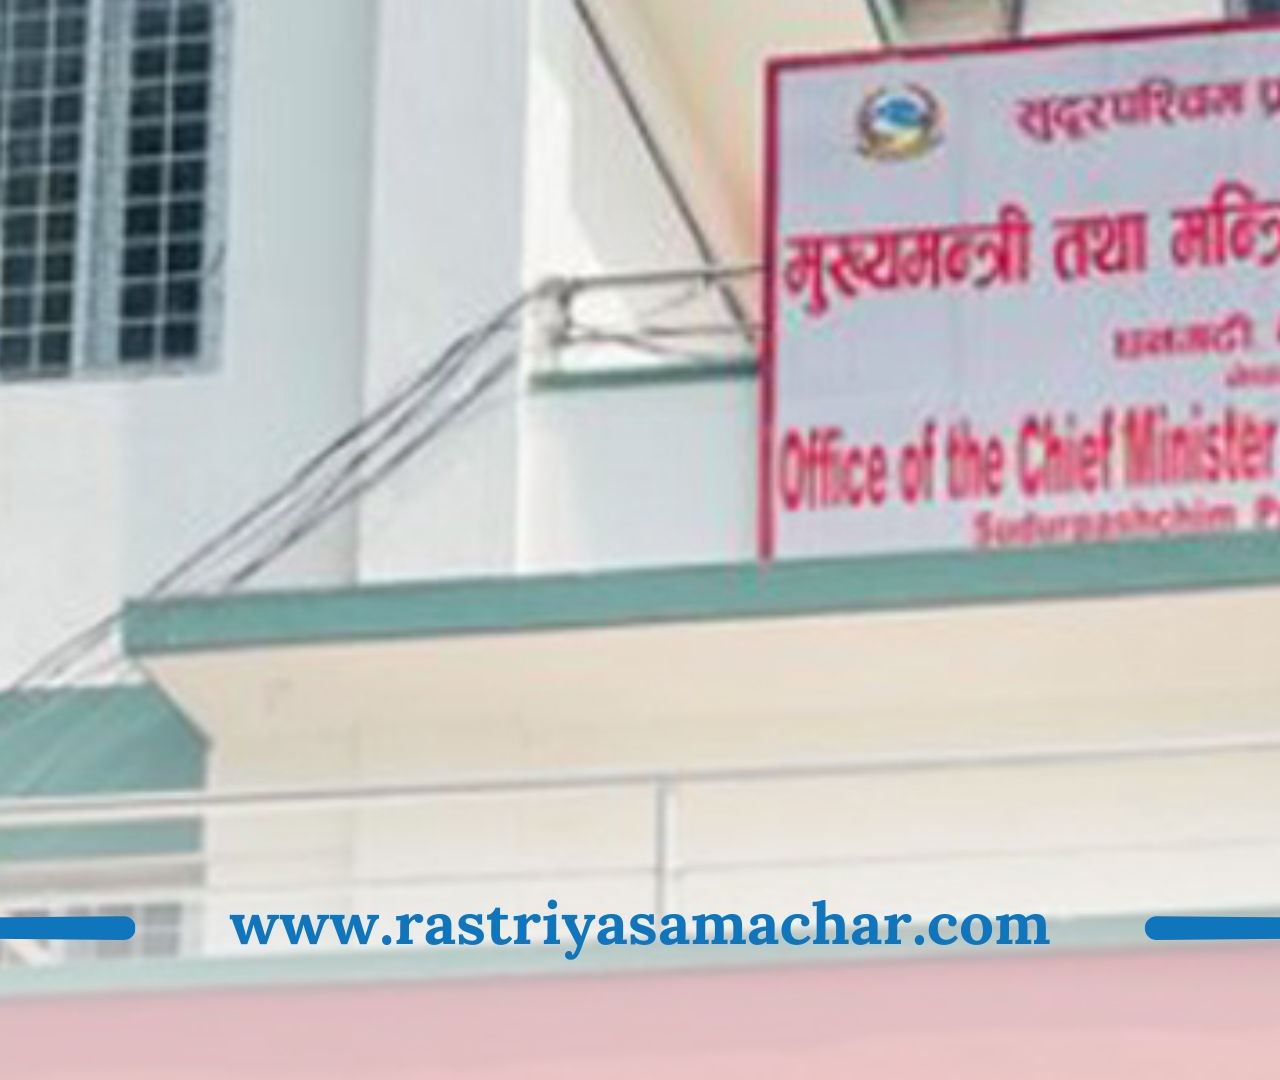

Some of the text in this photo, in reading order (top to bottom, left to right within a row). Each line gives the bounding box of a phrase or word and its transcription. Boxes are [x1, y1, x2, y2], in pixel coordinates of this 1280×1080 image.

[782, 203, 1032, 315] मुख्यमन्त्री
[1051, 212, 1147, 280] तथा
[780, 425, 888, 511] Office
[900, 419, 936, 503] of
[946, 422, 1004, 498] the
[1019, 407, 1114, 495] Chief
[1123, 402, 1279, 487] Minister
